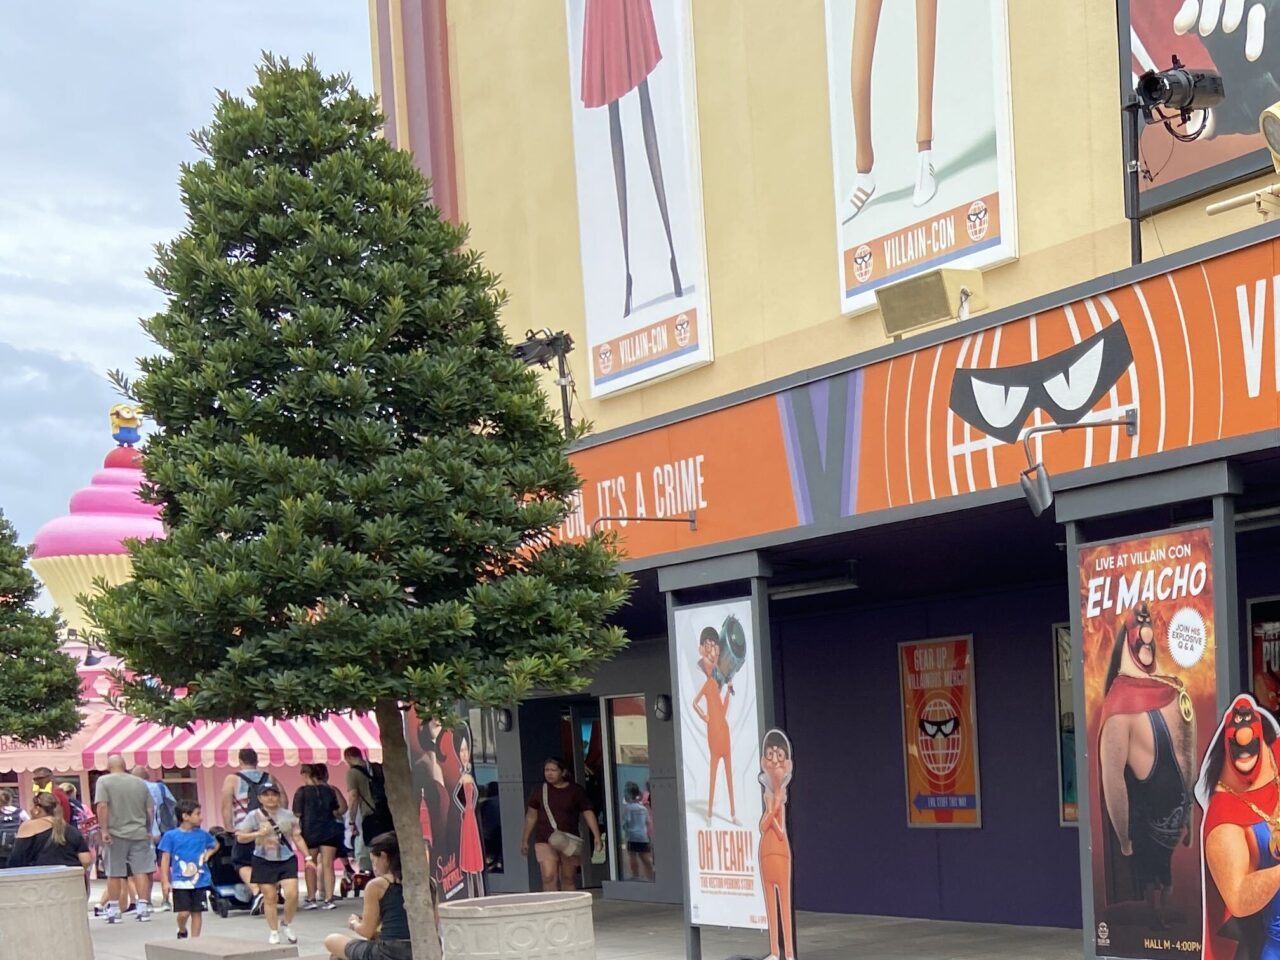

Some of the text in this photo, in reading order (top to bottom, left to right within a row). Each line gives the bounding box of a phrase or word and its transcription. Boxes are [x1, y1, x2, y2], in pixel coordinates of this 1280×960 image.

[883, 215, 956, 270] VILLAIN-CON
[618, 324, 669, 365] VILLAIN-CON
[597, 475, 628, 532] IT'S
[636, 471, 647, 523] A
[653, 454, 707, 518] CRIME
[1096, 543, 1192, 571] LIVE AT VILLAIN CON
[1086, 560, 1207, 619] EL MACHO
[1172, 631, 1202, 645] EXPLOSIVE
[1176, 624, 1201, 636] JOIN HIS
[914, 647, 947, 671] GEAR UP
[698, 830, 754, 873] OH YEAH!!
[1144, 938, 1163, 950] HALL
[1164, 940, 1171, 950] M
